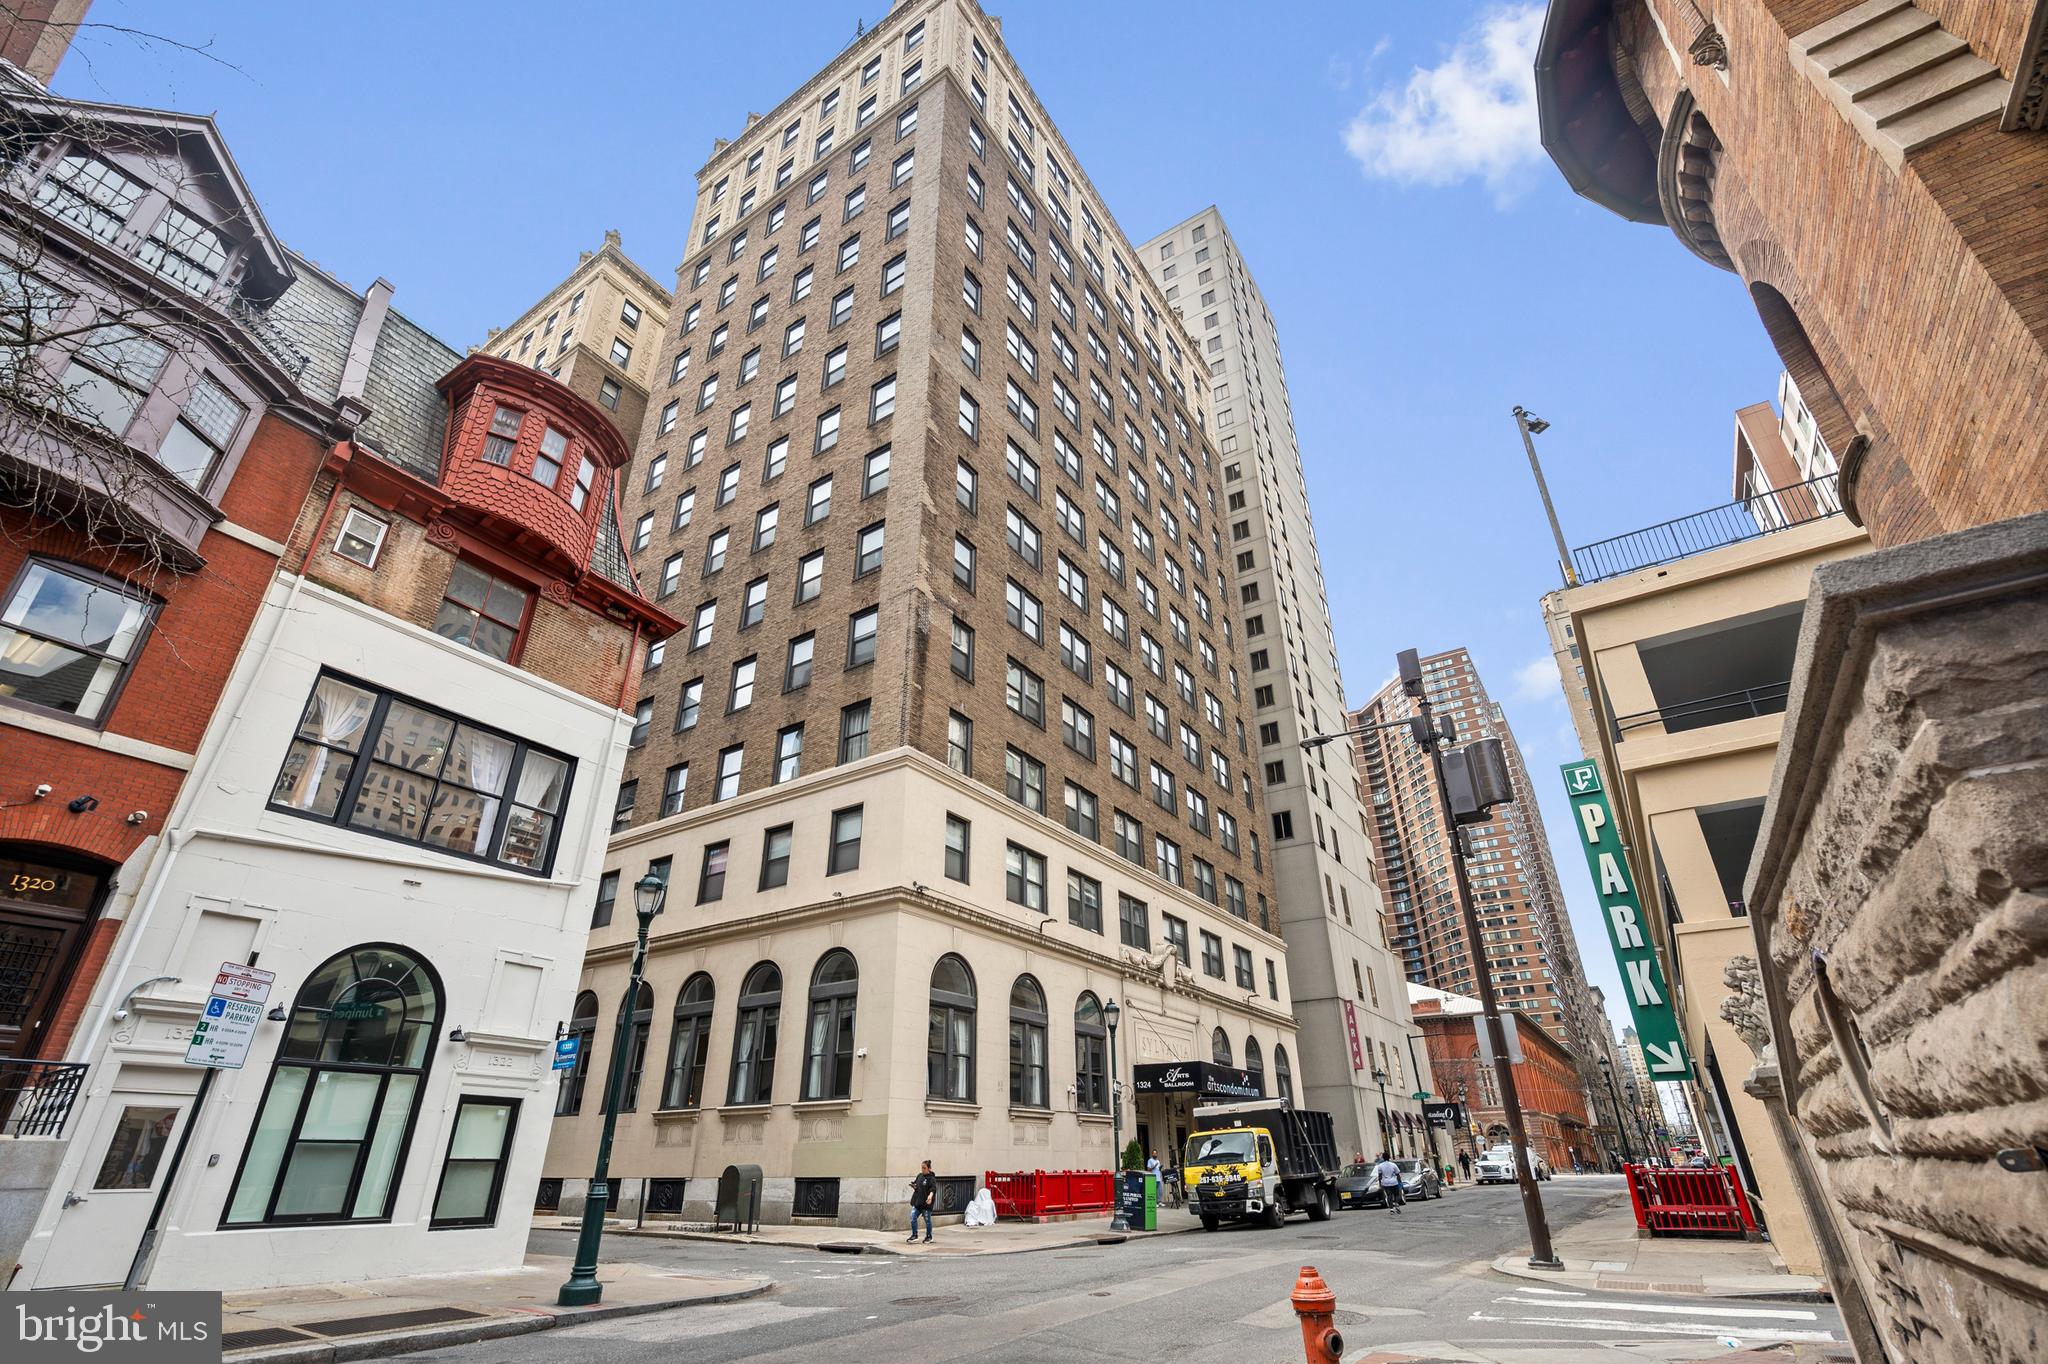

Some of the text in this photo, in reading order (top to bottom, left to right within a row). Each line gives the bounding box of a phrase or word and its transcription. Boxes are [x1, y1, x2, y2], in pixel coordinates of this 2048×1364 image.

[10, 874, 56, 892] 1320
[1578, 802, 1664, 1007] PARK
[217, 975, 262, 990] NO STOPPING
[226, 1001, 261, 1015] RESERVED
[225, 1011, 256, 1024] PARKING
[209, 1024, 219, 1032] HR
[1346, 1002, 1359, 1052] PARK
[205, 1037, 214, 1045] HR
[1142, 1036, 1190, 1059] SYLVANIA
[488, 1055, 513, 1067] 1322
[1206, 1081, 1260, 1097] artscondominium
